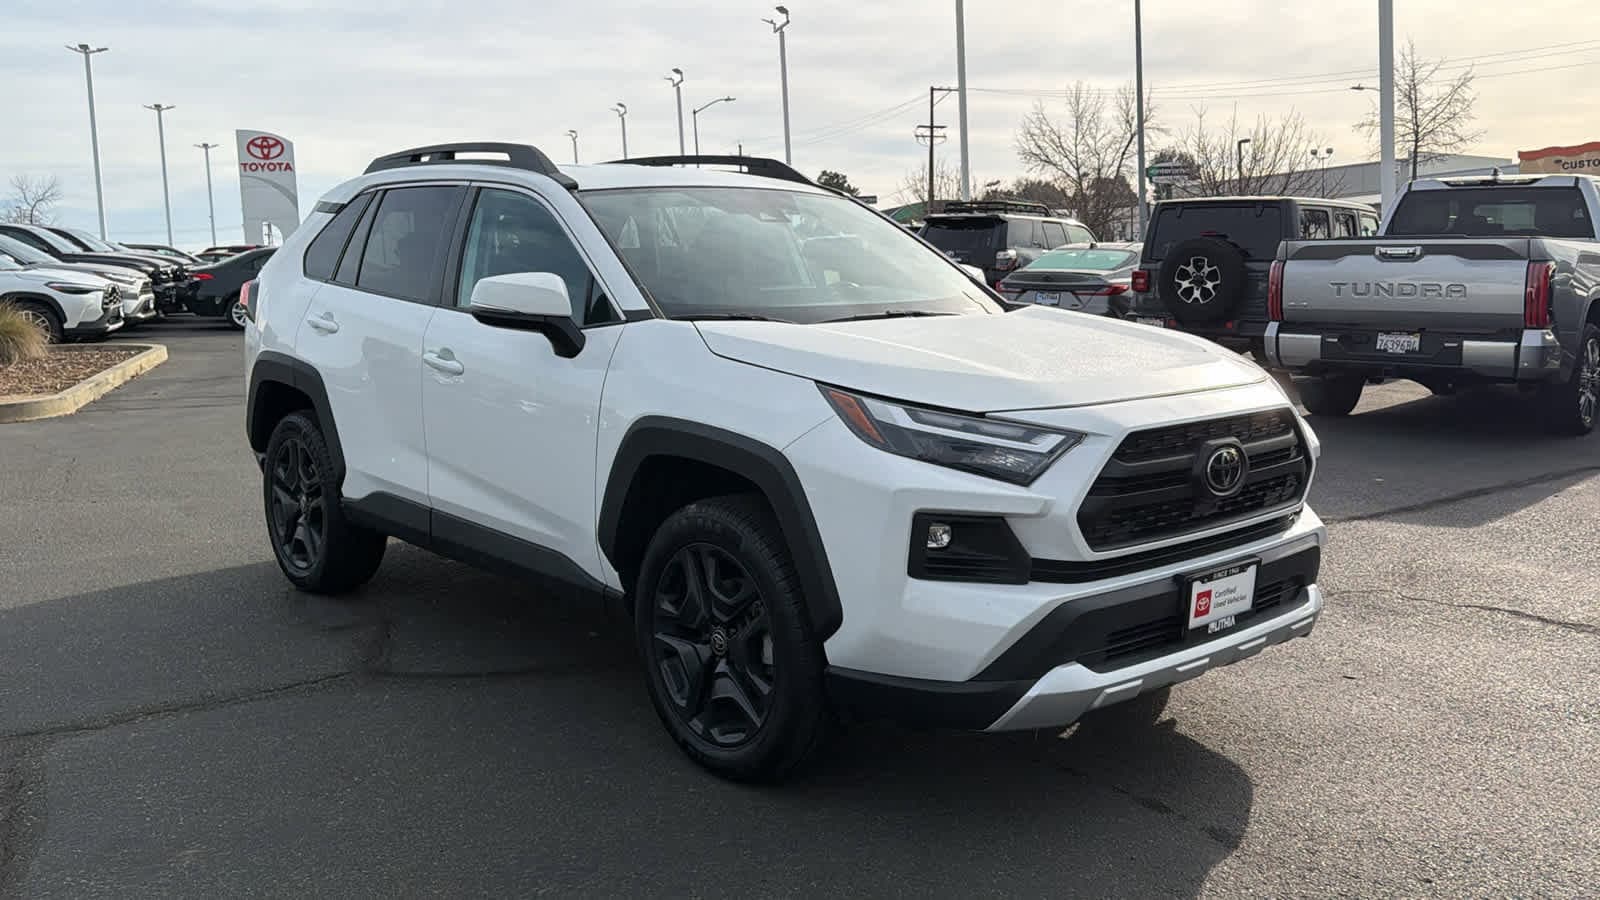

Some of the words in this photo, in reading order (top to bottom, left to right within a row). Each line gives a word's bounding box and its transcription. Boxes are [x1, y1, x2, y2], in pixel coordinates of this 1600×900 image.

[240, 162, 293, 172] TOYOTA
[1562, 159, 1600, 170] CUSTO
[1329, 281, 1468, 299] TUNDRA
[1214, 586, 1237, 599] Certified
[1213, 599, 1227, 609] Used
